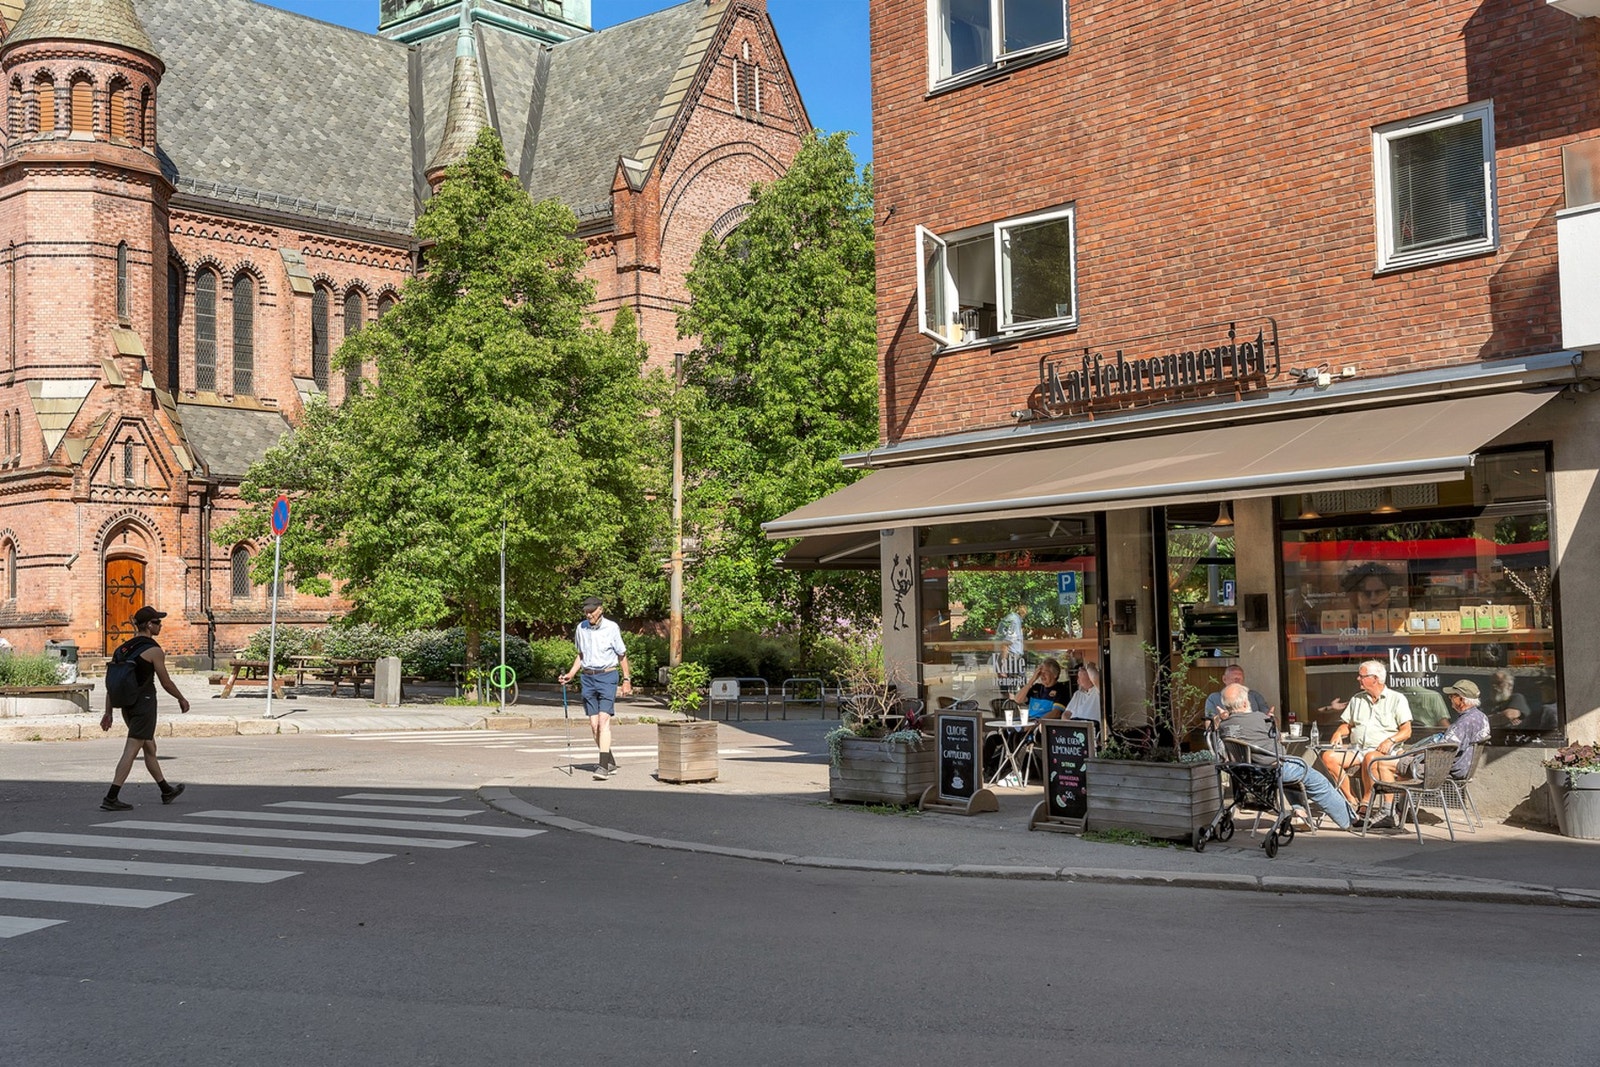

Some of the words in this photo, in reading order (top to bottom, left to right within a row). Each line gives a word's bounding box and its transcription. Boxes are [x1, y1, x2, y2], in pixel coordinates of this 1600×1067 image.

[1047, 326, 1268, 404] Kaffebrenneriet
[1061, 574, 1071, 591] P
[1225, 582, 1233, 598] P
[992, 652, 1026, 674] Kaffe
[1388, 646, 1439, 673] Kaffe
[1389, 674, 1440, 688] brenneriet
[1051, 745, 1082, 757] LIMONADE
